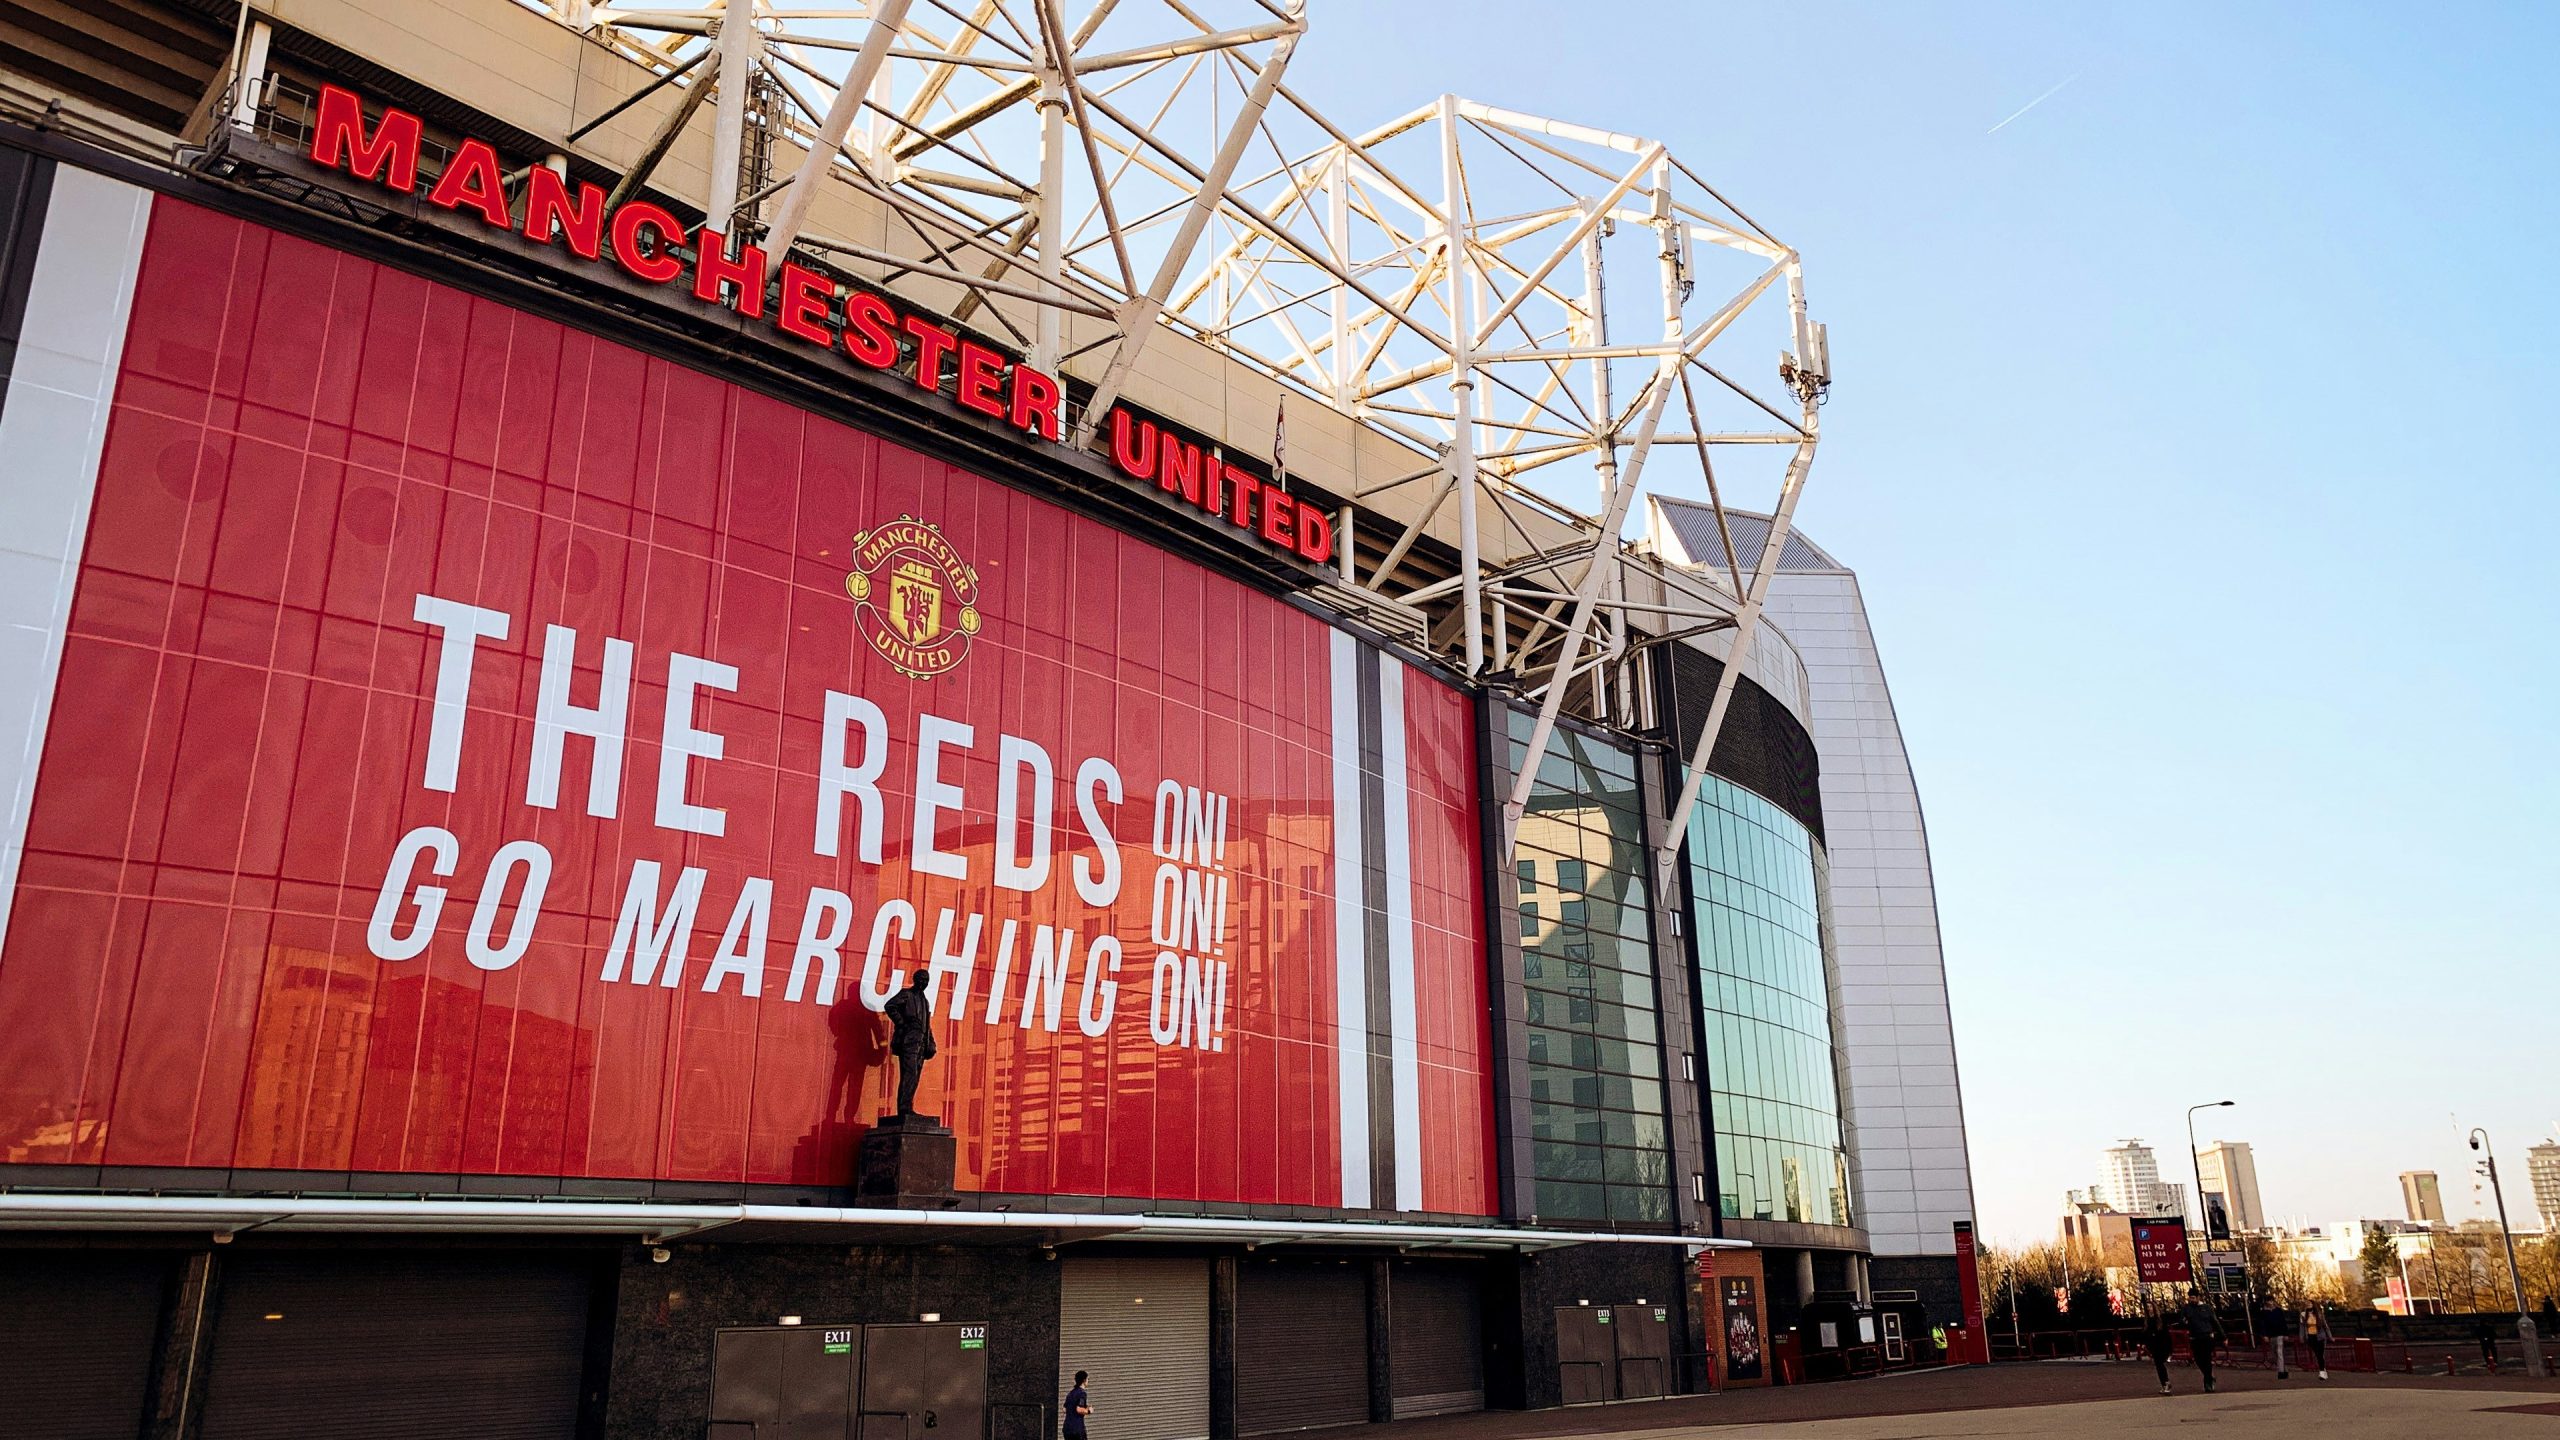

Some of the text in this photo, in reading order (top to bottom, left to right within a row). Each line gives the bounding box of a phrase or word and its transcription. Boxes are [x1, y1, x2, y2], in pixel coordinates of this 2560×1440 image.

[310, 82, 1333, 563] MANCHESTER UNITED
[862, 526, 969, 595] MANCHESTER
[875, 629, 952, 668] UNITED
[413, 593, 1124, 908] THE REDS
[1152, 778, 1229, 872] ON!
[366, 826, 1122, 1038] GO MARCHING
[1151, 862, 1229, 956] ON!
[1149, 950, 1228, 1053] ON!
[825, 1331, 851, 1343] EX11
[960, 1327, 985, 1339] EX12
